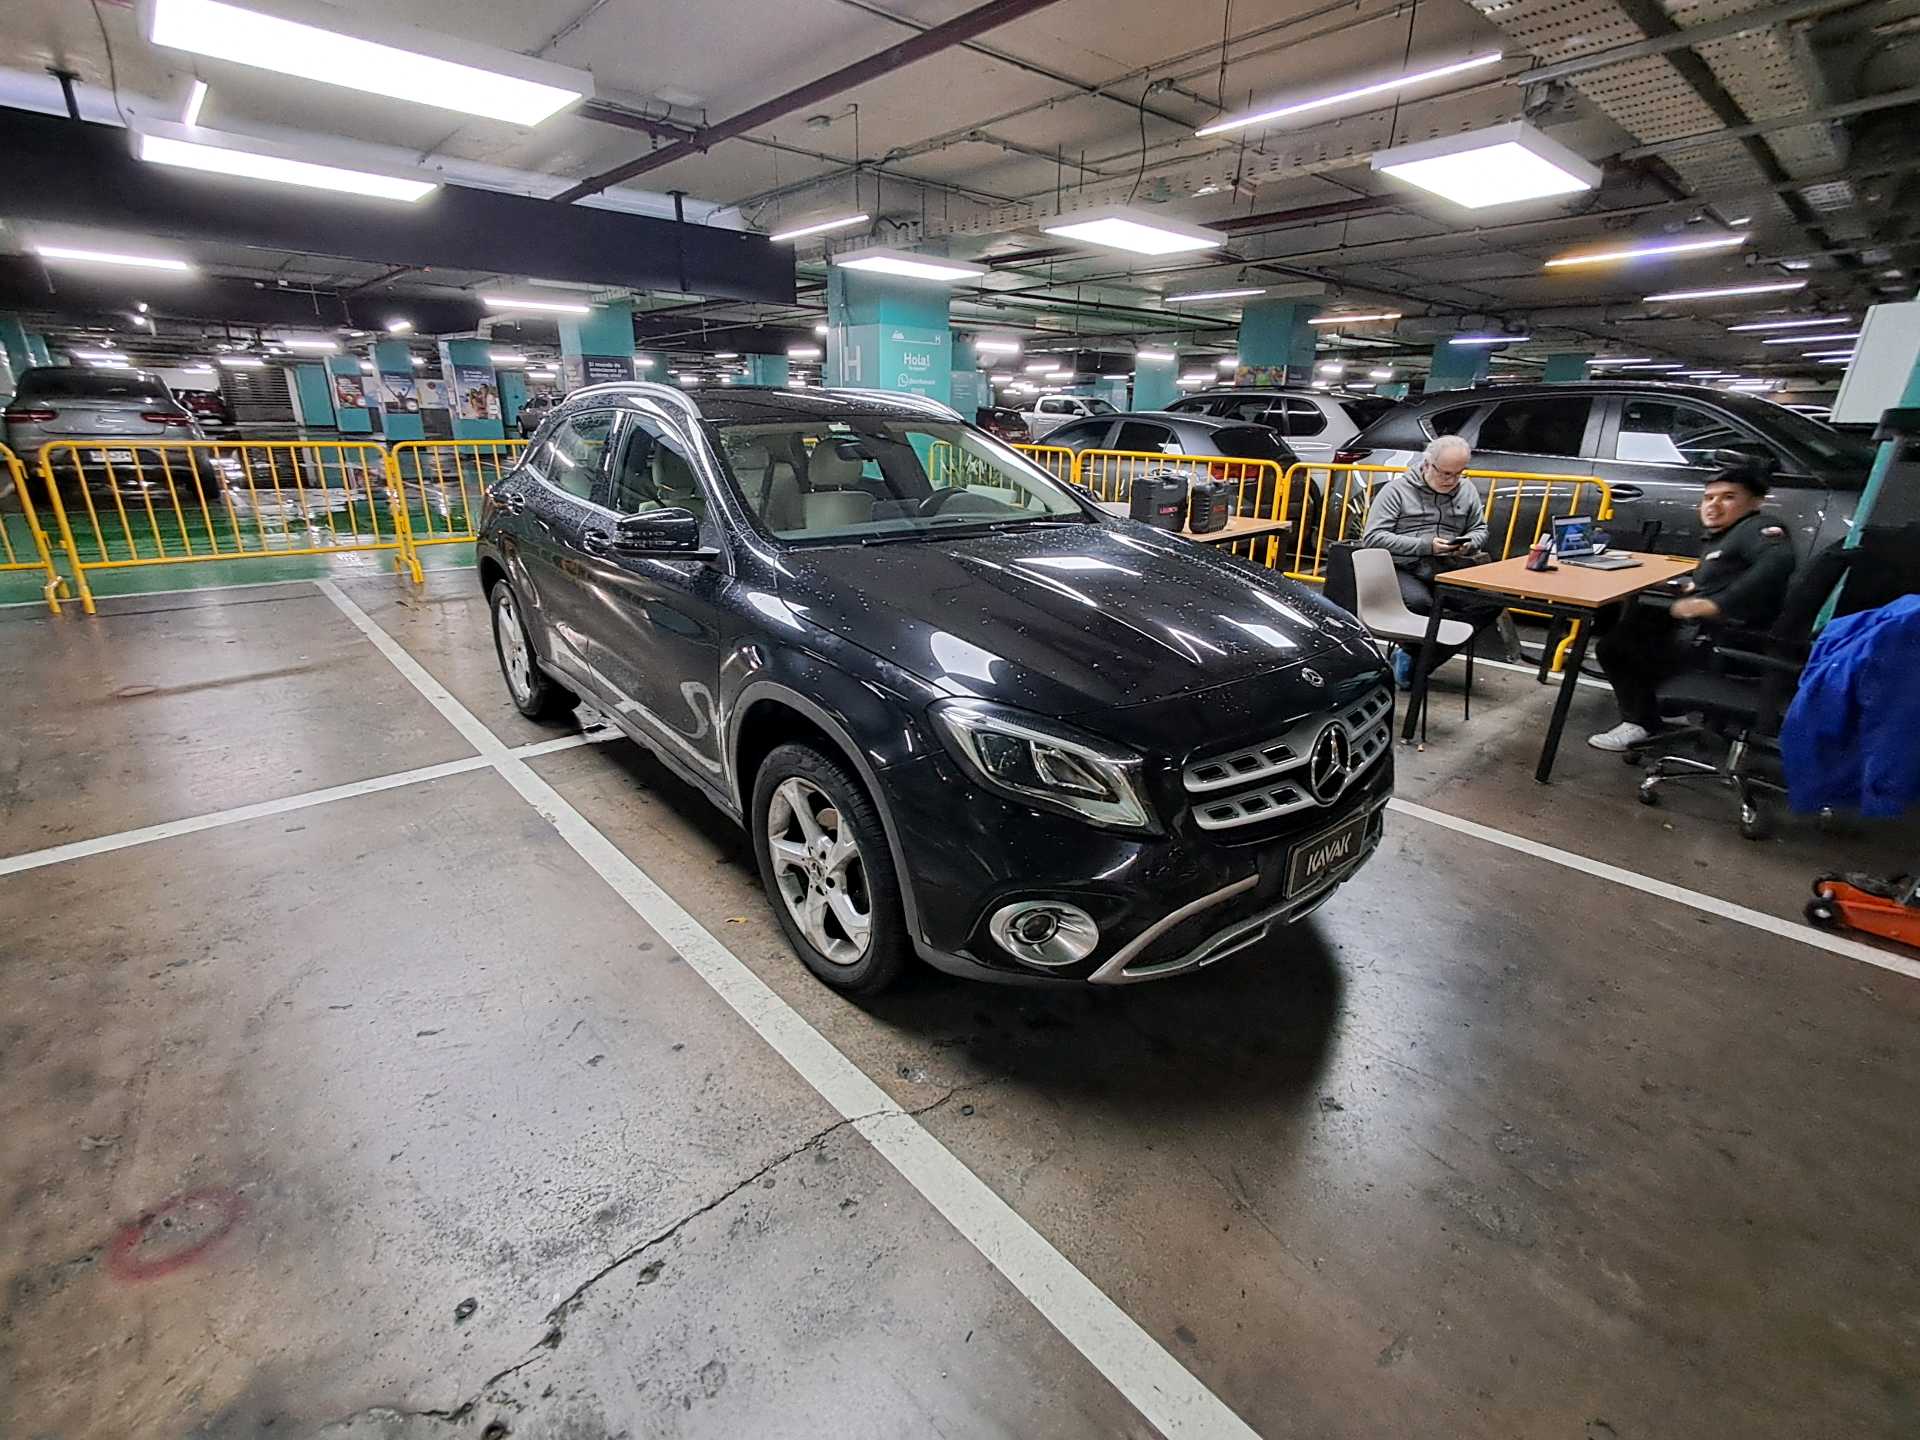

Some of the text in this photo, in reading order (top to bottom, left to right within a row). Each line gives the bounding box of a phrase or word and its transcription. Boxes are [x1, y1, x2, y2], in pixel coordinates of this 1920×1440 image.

[844, 345, 862, 382] H
[903, 351, 931, 367] Hola!
[1306, 832, 1352, 877] KAVAK
